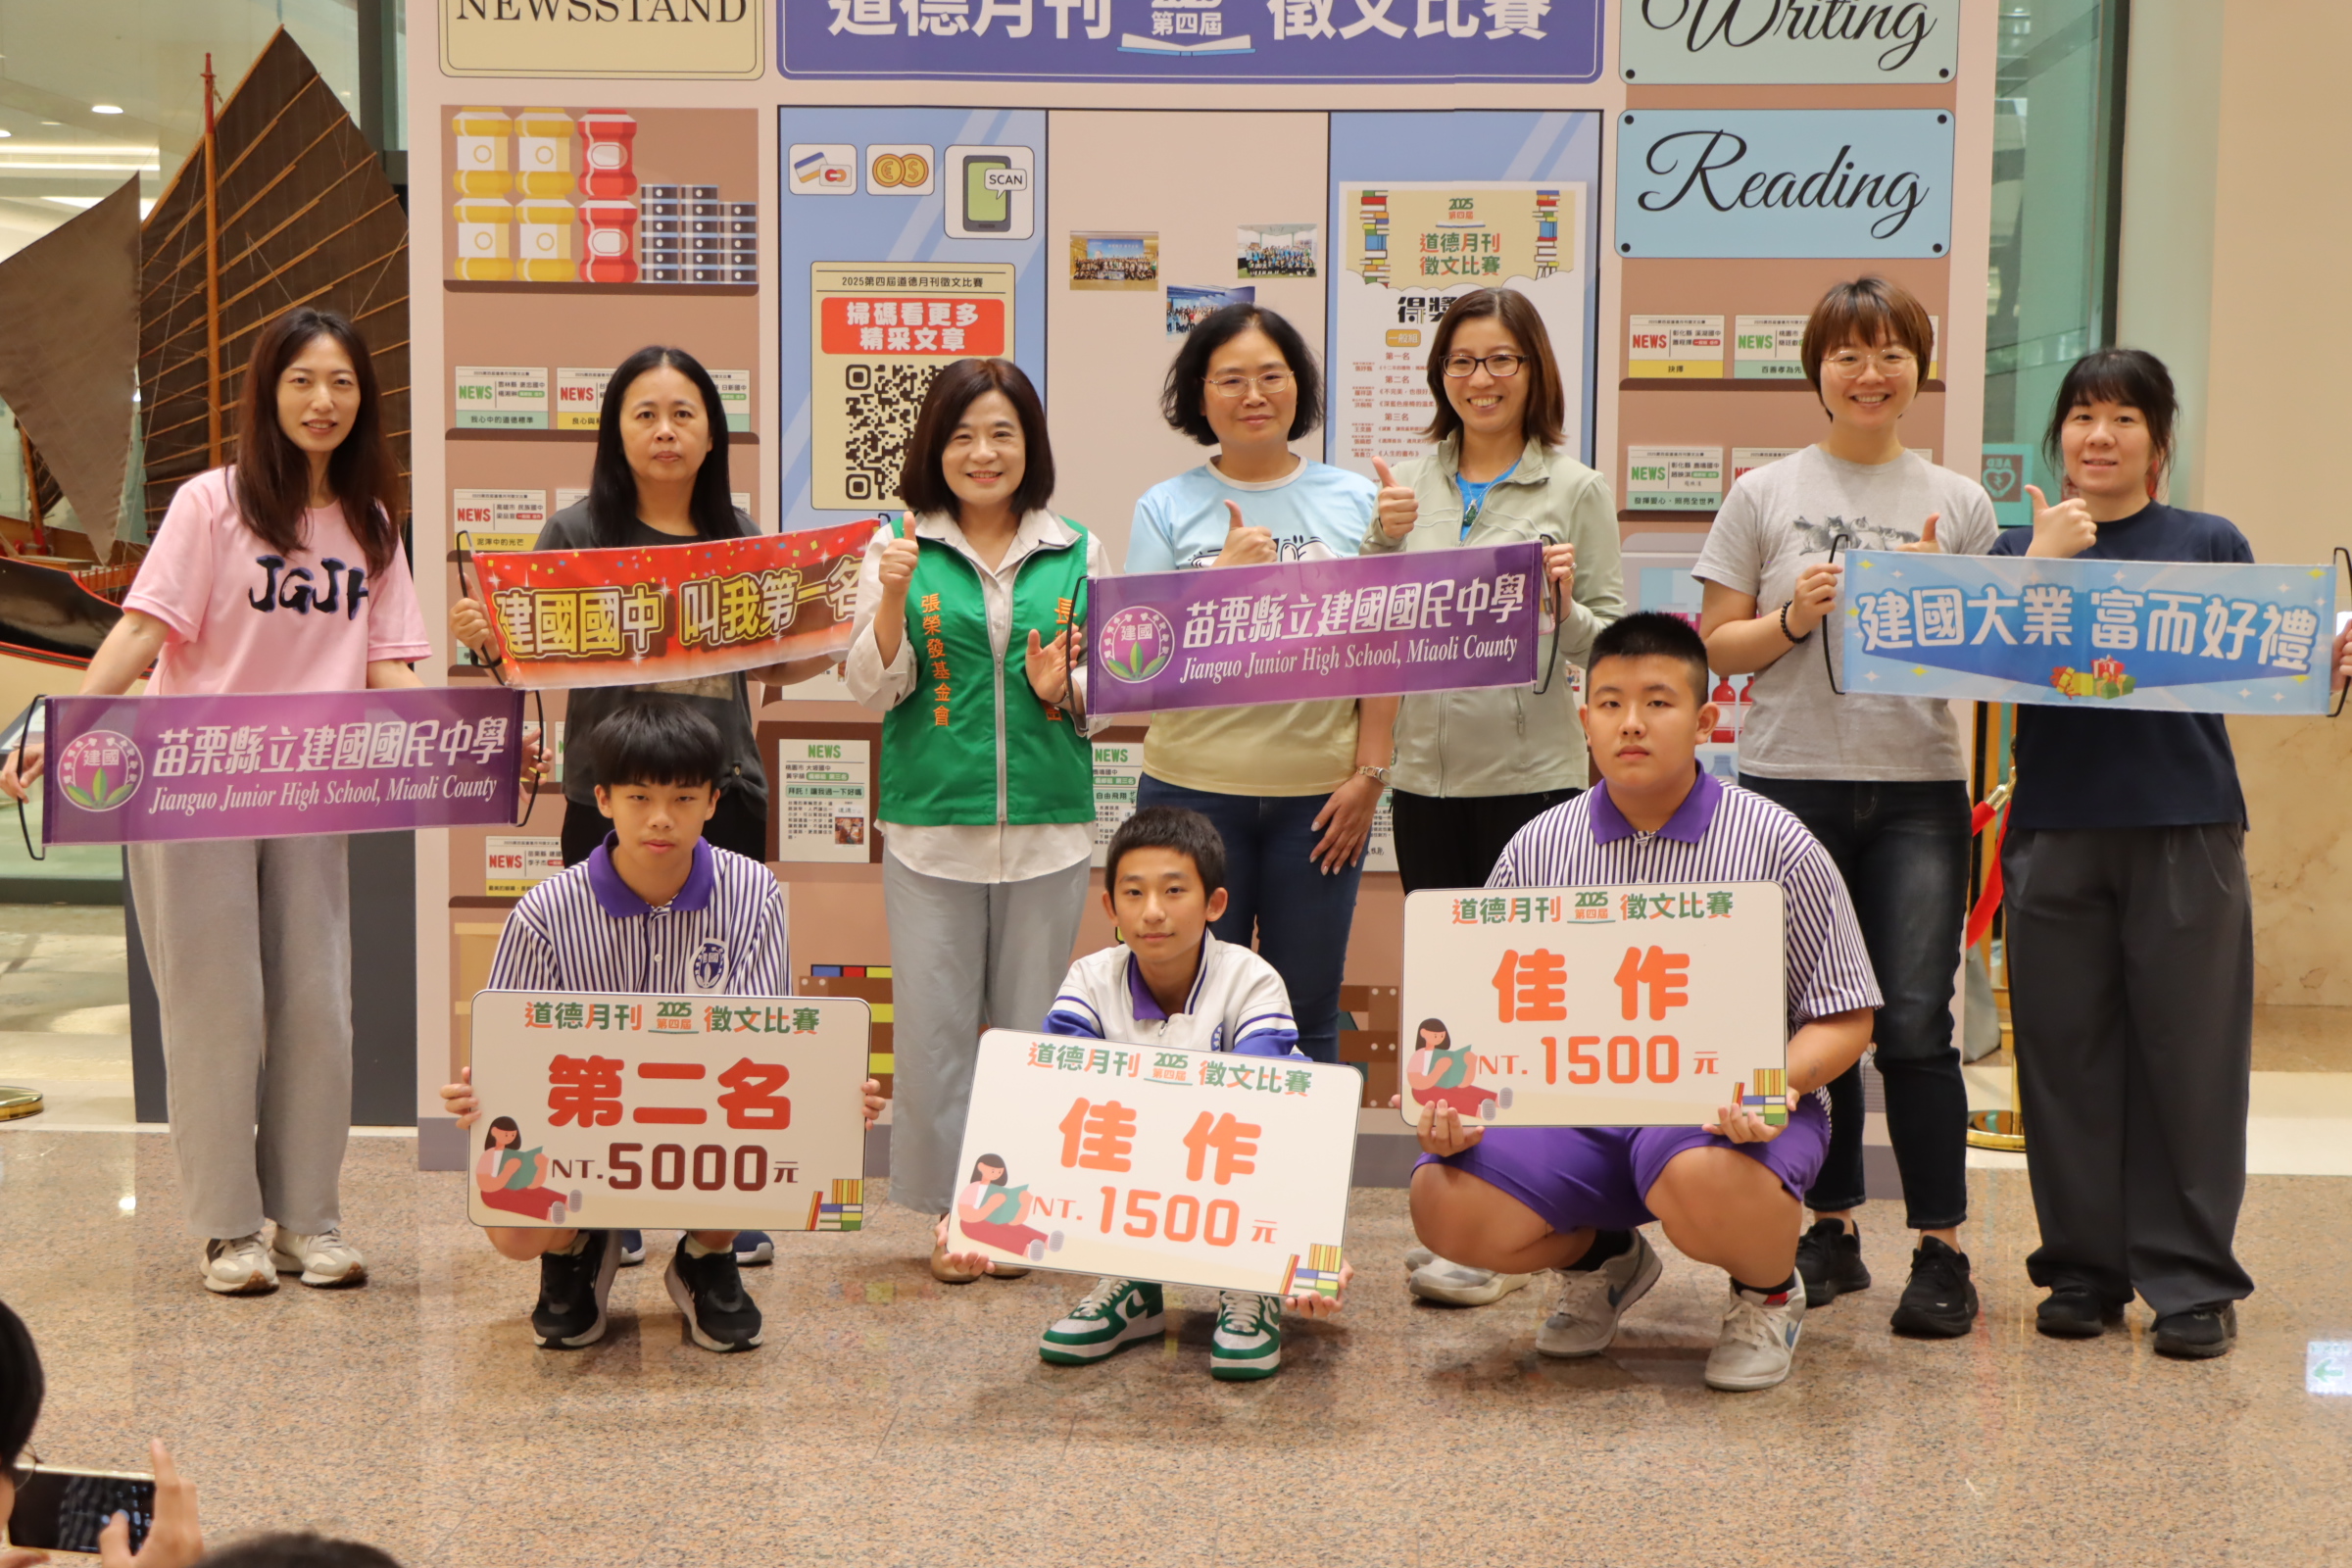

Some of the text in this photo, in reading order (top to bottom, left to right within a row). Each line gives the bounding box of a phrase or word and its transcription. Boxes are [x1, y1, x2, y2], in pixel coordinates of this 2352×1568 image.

[457, 0, 746, 22] NEWSSTAND
[1152, 12, 1222, 36] 第四屆
[1642, 0, 1937, 71] Writing
[989, 174, 1023, 186] SCAN
[1638, 128, 1930, 239] Reading
[1448, 198, 1474, 210] 2025
[1448, 211, 1474, 220] 第四屆
[1419, 233, 1500, 253] 道德月刊
[1419, 256, 1500, 276] 徵文比賽
[842, 276, 984, 288] 2025第四屆道德月刊徵文比賽
[847, 302, 979, 326] 掃碼看更多
[859, 327, 965, 351] 精采文章
[1388, 333, 1418, 344] 一般組
[1633, 334, 1667, 349] NEWS
[1738, 334, 1773, 350] NEWS
[1385, 352, 1410, 361] 第一名
[1385, 375, 1410, 384] 第二名
[459, 385, 493, 400] NEWS
[560, 387, 594, 402] NEWS
[1385, 413, 1409, 421] 第三名
[1631, 466, 1666, 481] NEWS
[457, 508, 491, 522] NEWS
[495, 558, 861, 655] 建國國中 叫我第一名
[1183, 572, 1526, 649] 苗栗縣立建國國民中學
[1120, 623, 1153, 641] 建國
[1860, 586, 2319, 671] 建國大業 富而好禮
[920, 593, 953, 726] 張榮發基金會
[1179, 633, 1518, 685] Jianguo Junior High School, Miaoli County
[152, 715, 508, 777] 苗栗縣立建國國民中學
[808, 744, 841, 759] NEWS
[83, 749, 120, 766] 建國
[1095, 748, 1128, 762] NEWS
[148, 773, 498, 816] Jianguo Junior High School, Miaoli County
[489, 855, 522, 869] NEWS
[1451, 890, 1734, 924] 道德月刊 徵文比賽
[1574, 892, 1608, 907] 2025
[1574, 907, 1608, 920] 第四屆
[657, 1002, 692, 1017] 2025
[523, 1001, 819, 1035] 道德月刊 徵文比賽
[656, 1018, 692, 1030] 第四屆
[1152, 1052, 1189, 1069] 2025
[1027, 1041, 1313, 1098] 道德月刊 徵文比賽
[1152, 1067, 1187, 1082] 第四屆
[548, 1054, 791, 1130] 第二名
